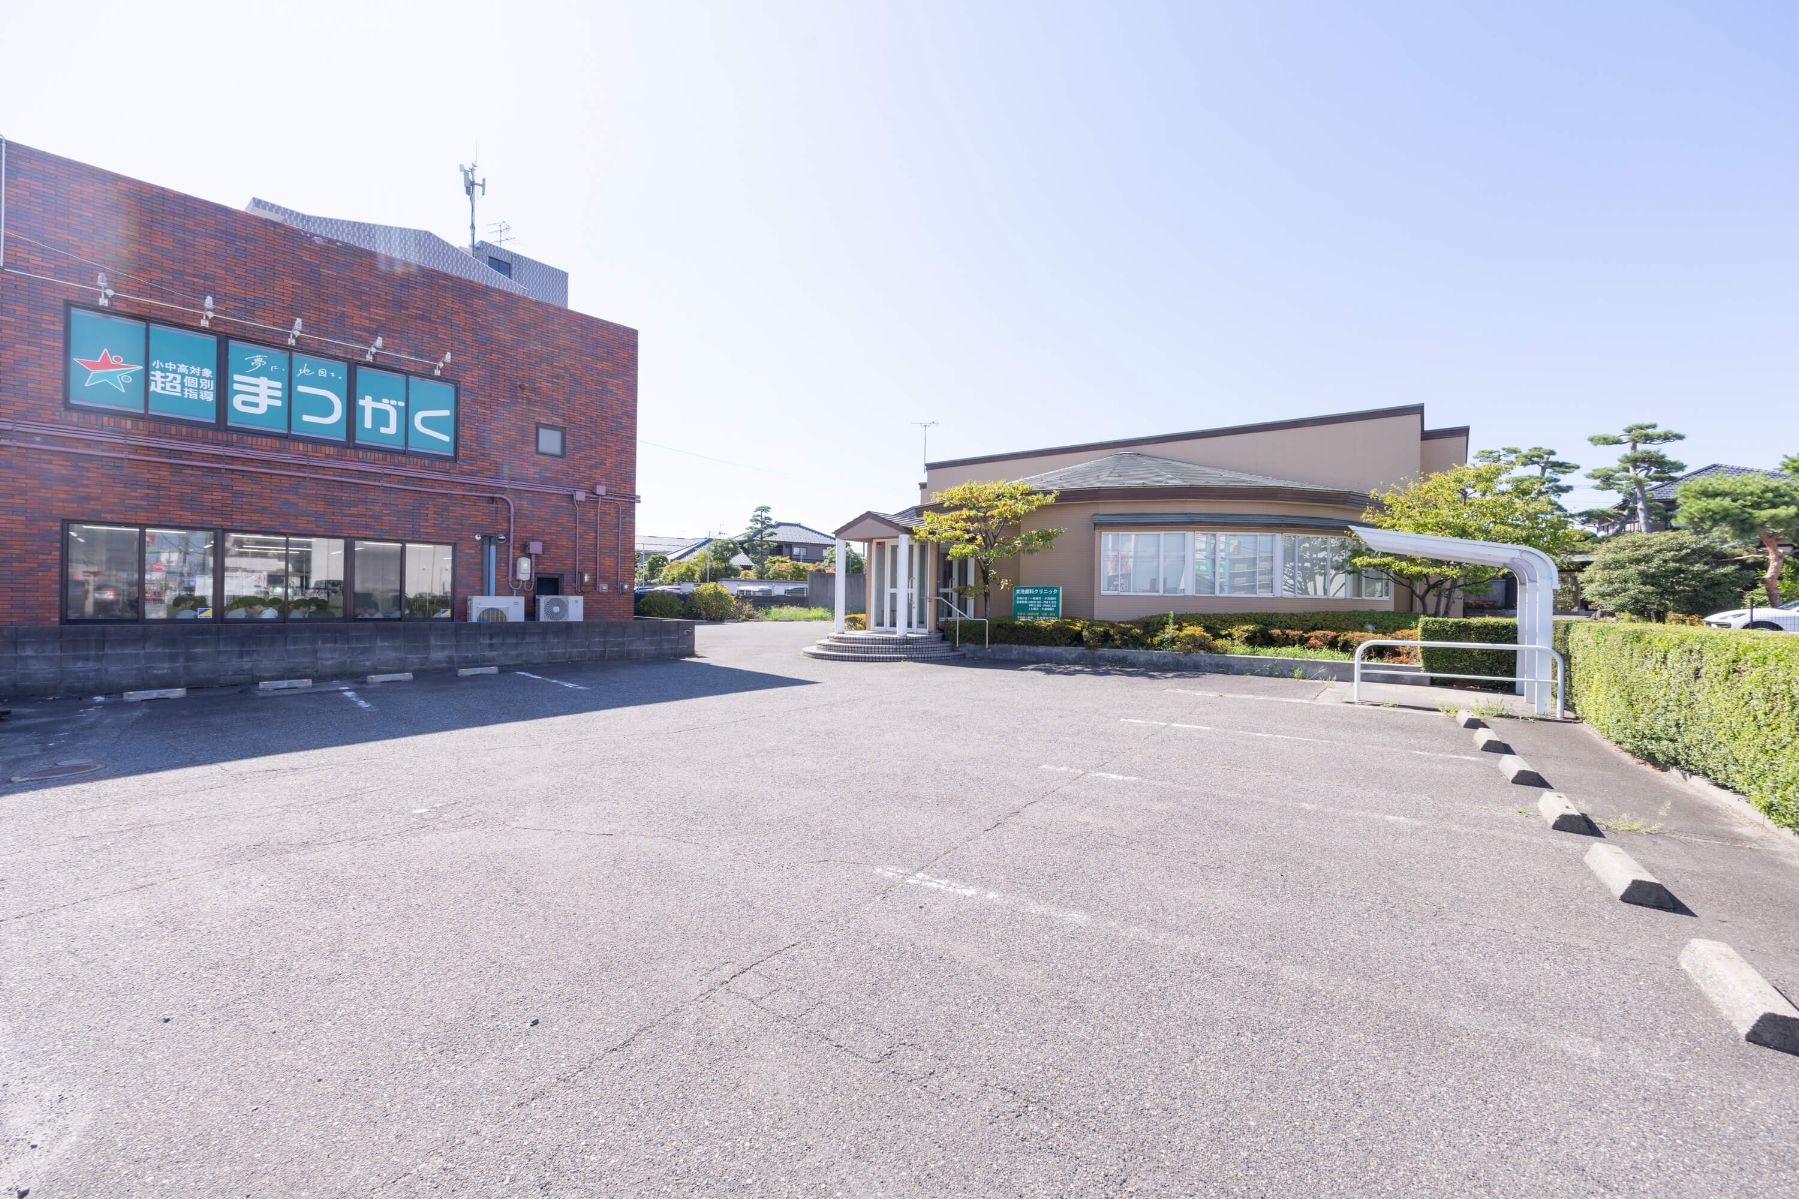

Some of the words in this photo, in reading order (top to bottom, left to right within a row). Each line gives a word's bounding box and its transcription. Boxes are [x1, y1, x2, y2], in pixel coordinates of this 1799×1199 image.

[151, 359, 213, 378] 小中高対象
[149, 370, 182, 397] 超
[183, 375, 214, 390] 個別
[183, 387, 214, 402] 指導
[233, 373, 451, 442] まつがく
